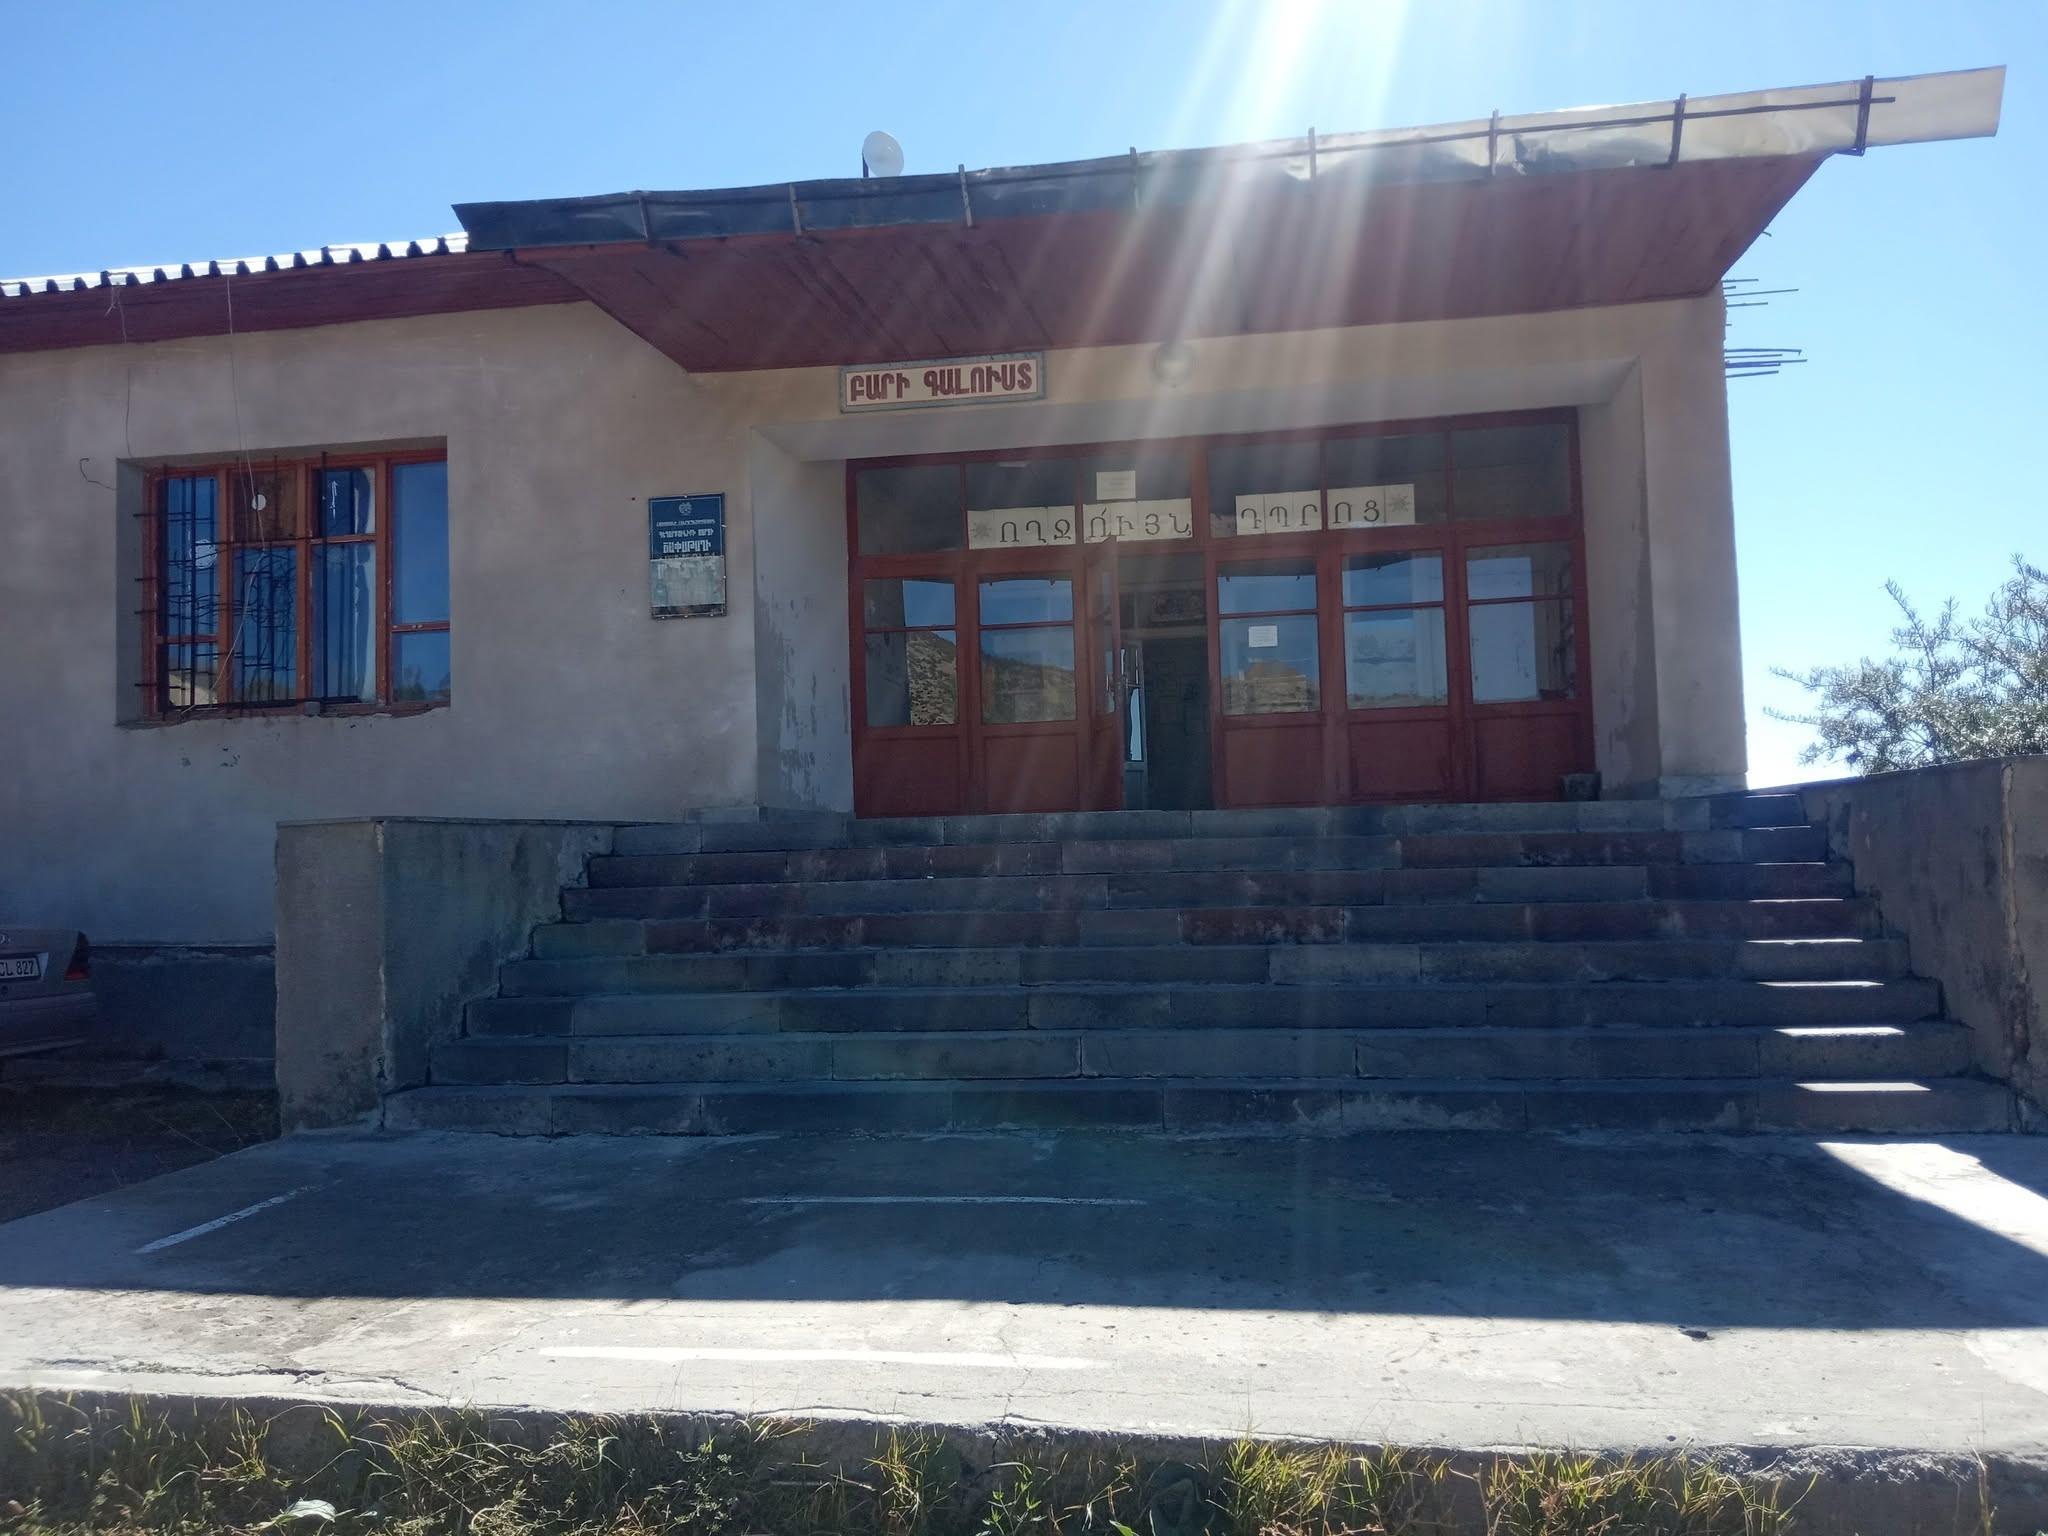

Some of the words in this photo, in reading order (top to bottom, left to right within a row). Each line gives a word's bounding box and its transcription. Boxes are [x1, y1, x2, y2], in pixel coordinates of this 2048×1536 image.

[850, 372, 910, 402] ԲԱՐԻ
[923, 362, 1032, 397] ԳԱԼՈՒՍՏ
[1240, 499, 1380, 529] ԴՊՐՈՑ
[16, 960, 34, 976] 827
